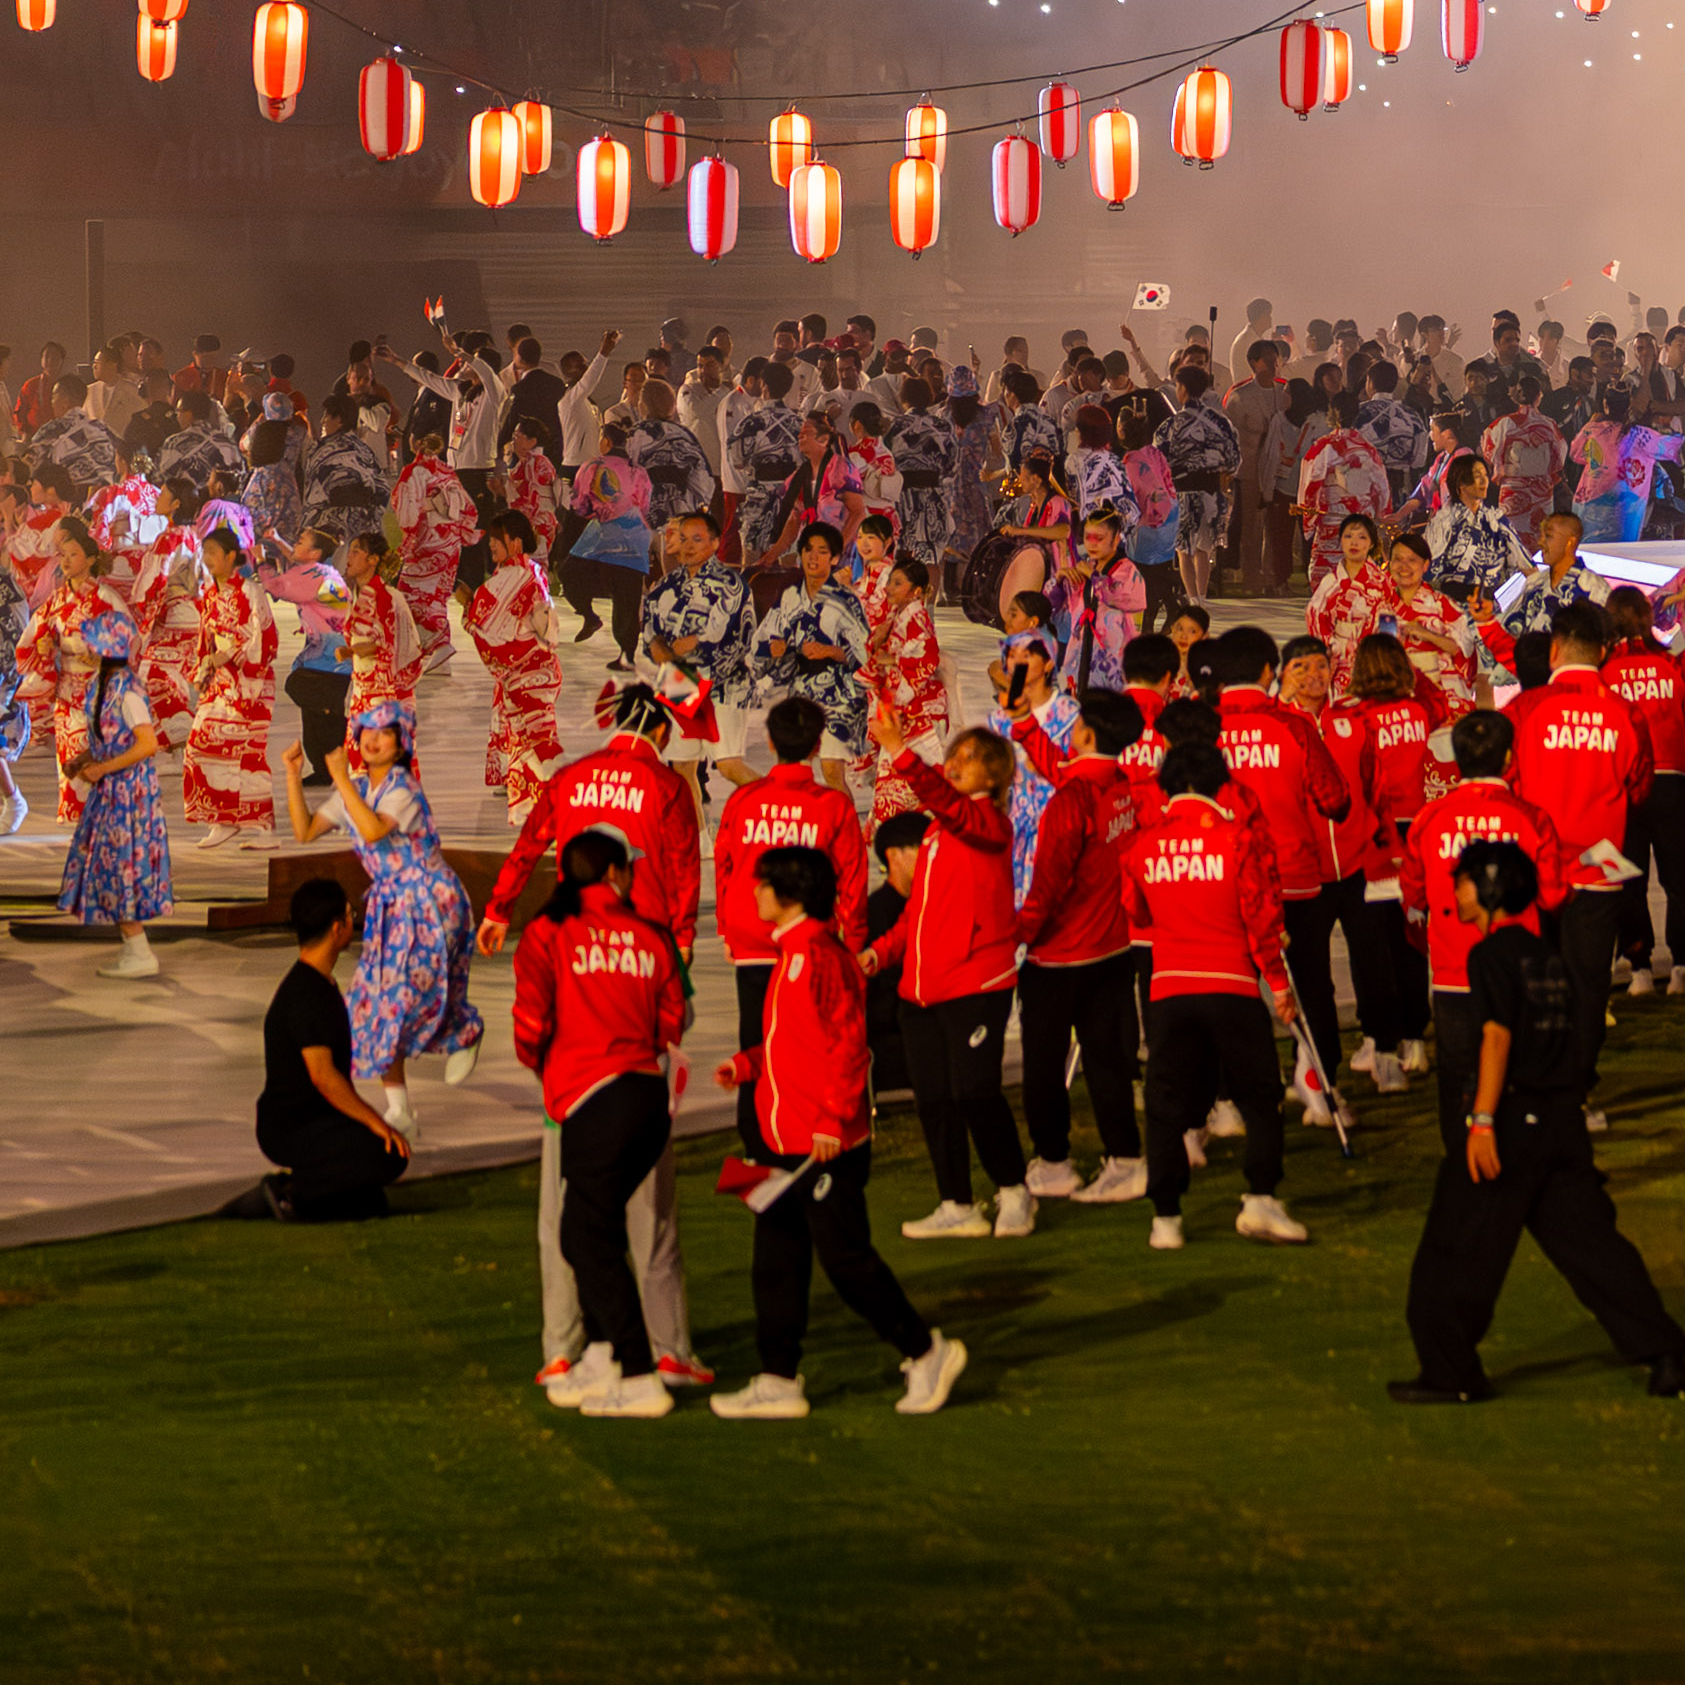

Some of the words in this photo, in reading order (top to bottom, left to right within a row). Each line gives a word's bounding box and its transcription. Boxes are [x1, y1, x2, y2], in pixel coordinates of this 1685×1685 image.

[1621, 667, 1657, 680] TEAM
[1377, 709, 1410, 725] TEAM
[1562, 710, 1603, 725] TEAM
[1221, 729, 1261, 744] TEAM
[1378, 720, 1425, 749] APAN
[1544, 723, 1617, 751] JAPAN
[1117, 743, 1164, 768] PAN
[1223, 744, 1279, 769] APAN
[592, 769, 632, 783] TEAM
[570, 783, 644, 813] JAPAN
[760, 804, 802, 820] TEAM
[743, 817, 817, 848] JAPAN
[1456, 816, 1501, 831] TEAM
[1159, 838, 1203, 854] TEAM
[1145, 854, 1223, 883] JAPAN
[573, 944, 655, 977] JAPAN
